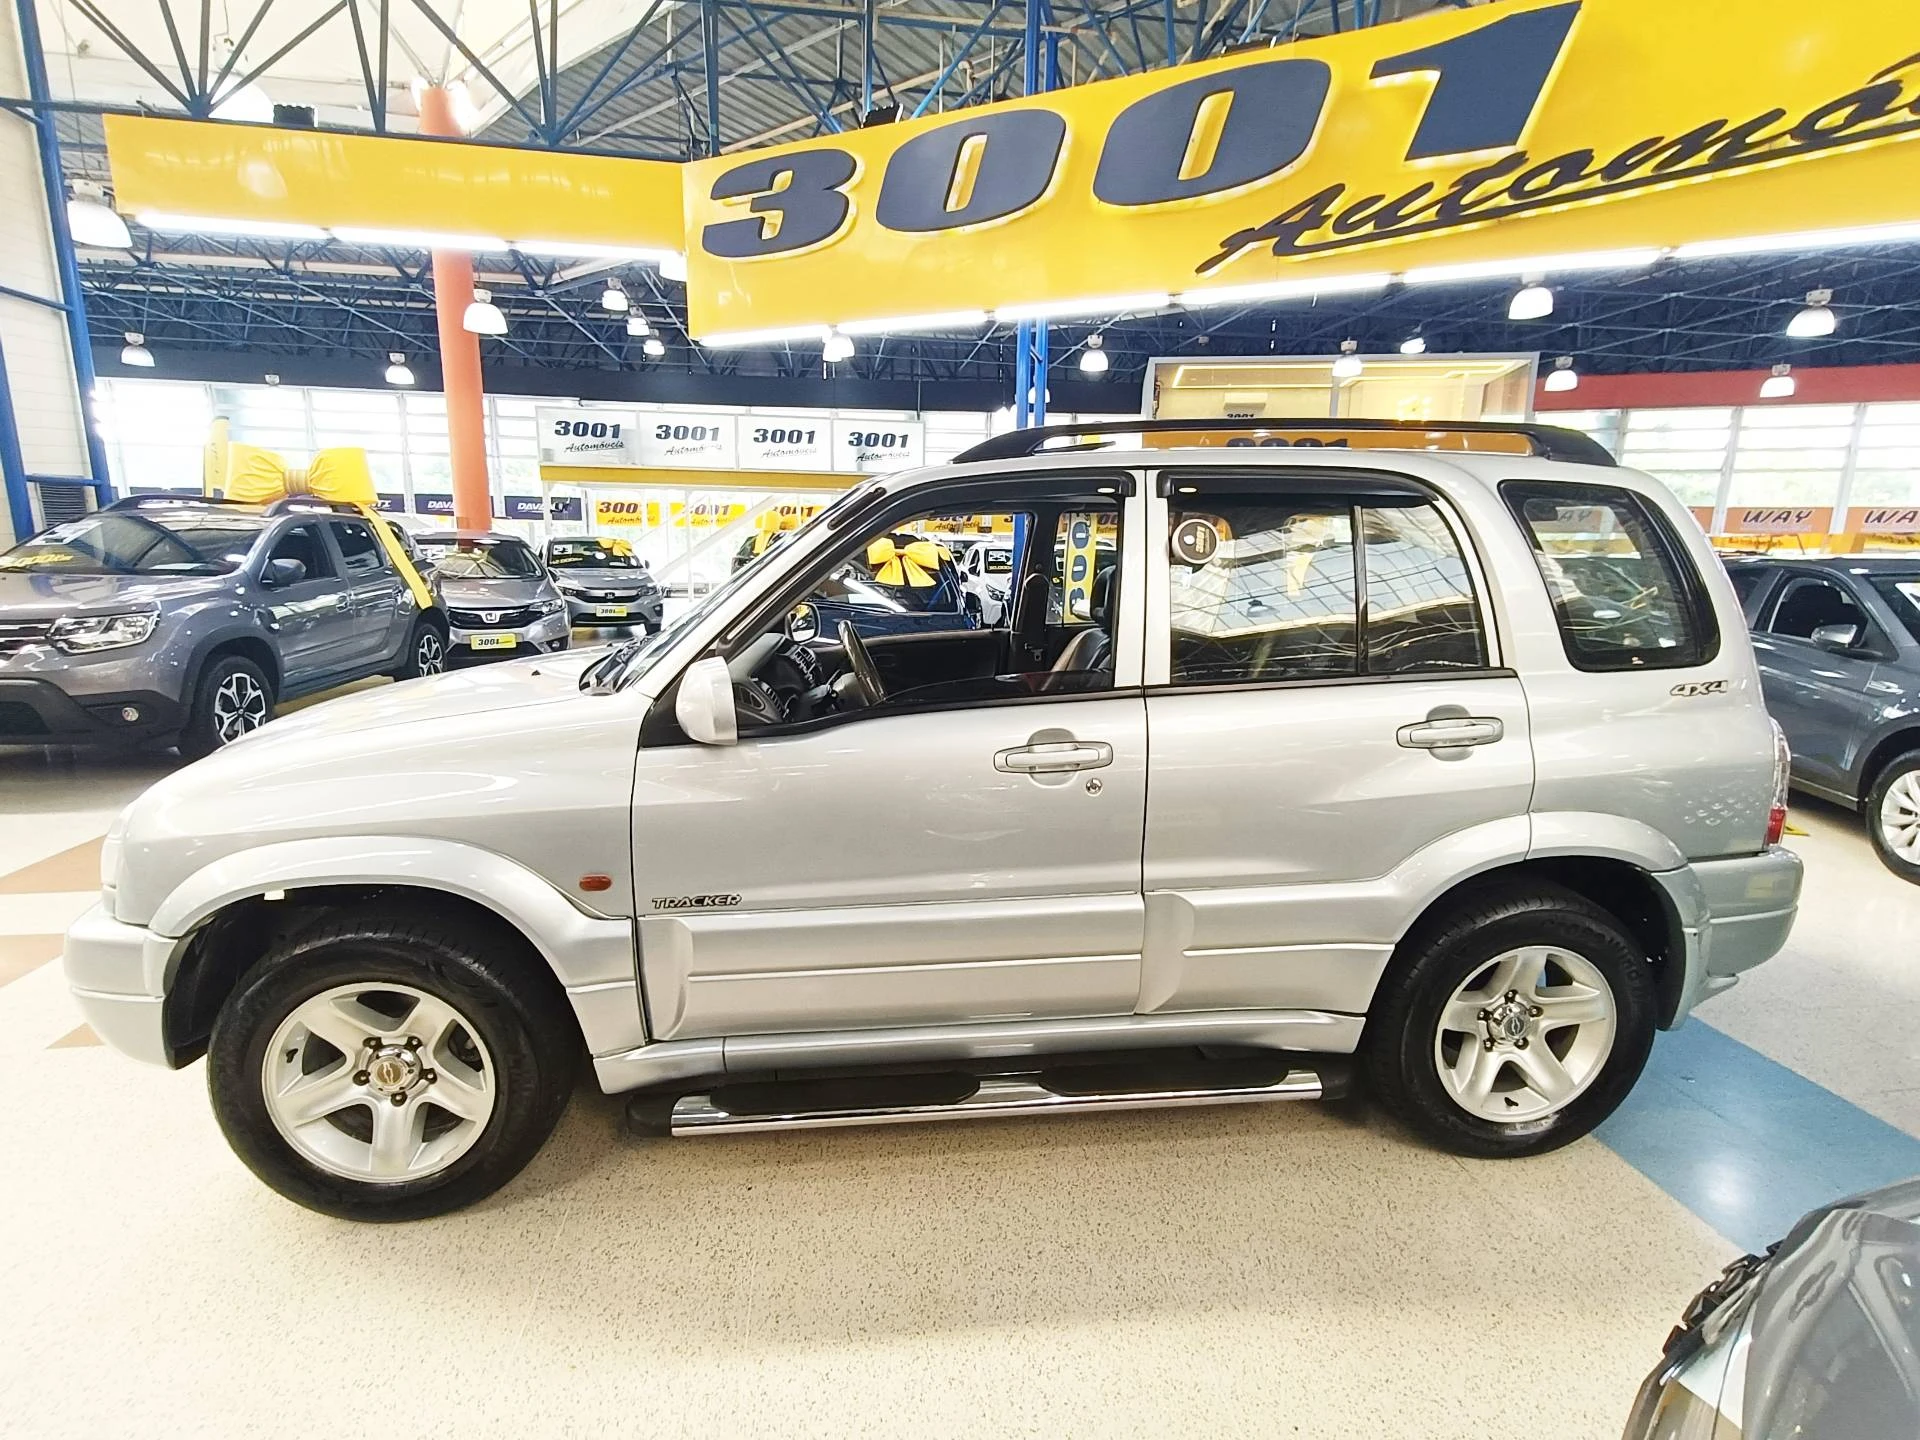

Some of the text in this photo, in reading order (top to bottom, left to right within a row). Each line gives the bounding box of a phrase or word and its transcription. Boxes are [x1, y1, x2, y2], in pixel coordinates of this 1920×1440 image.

[701, 0, 1582, 259] 3001
[1195, 50, 1920, 275] Automó
[554, 420, 621, 438] 3001
[655, 424, 720, 441] 3001
[753, 428, 816, 445] 3001
[848, 431, 909, 448] 3001
[1742, 510, 1814, 523] WAY
[1863, 510, 1920, 523] WA
[652, 893, 742, 909] TRACKER
